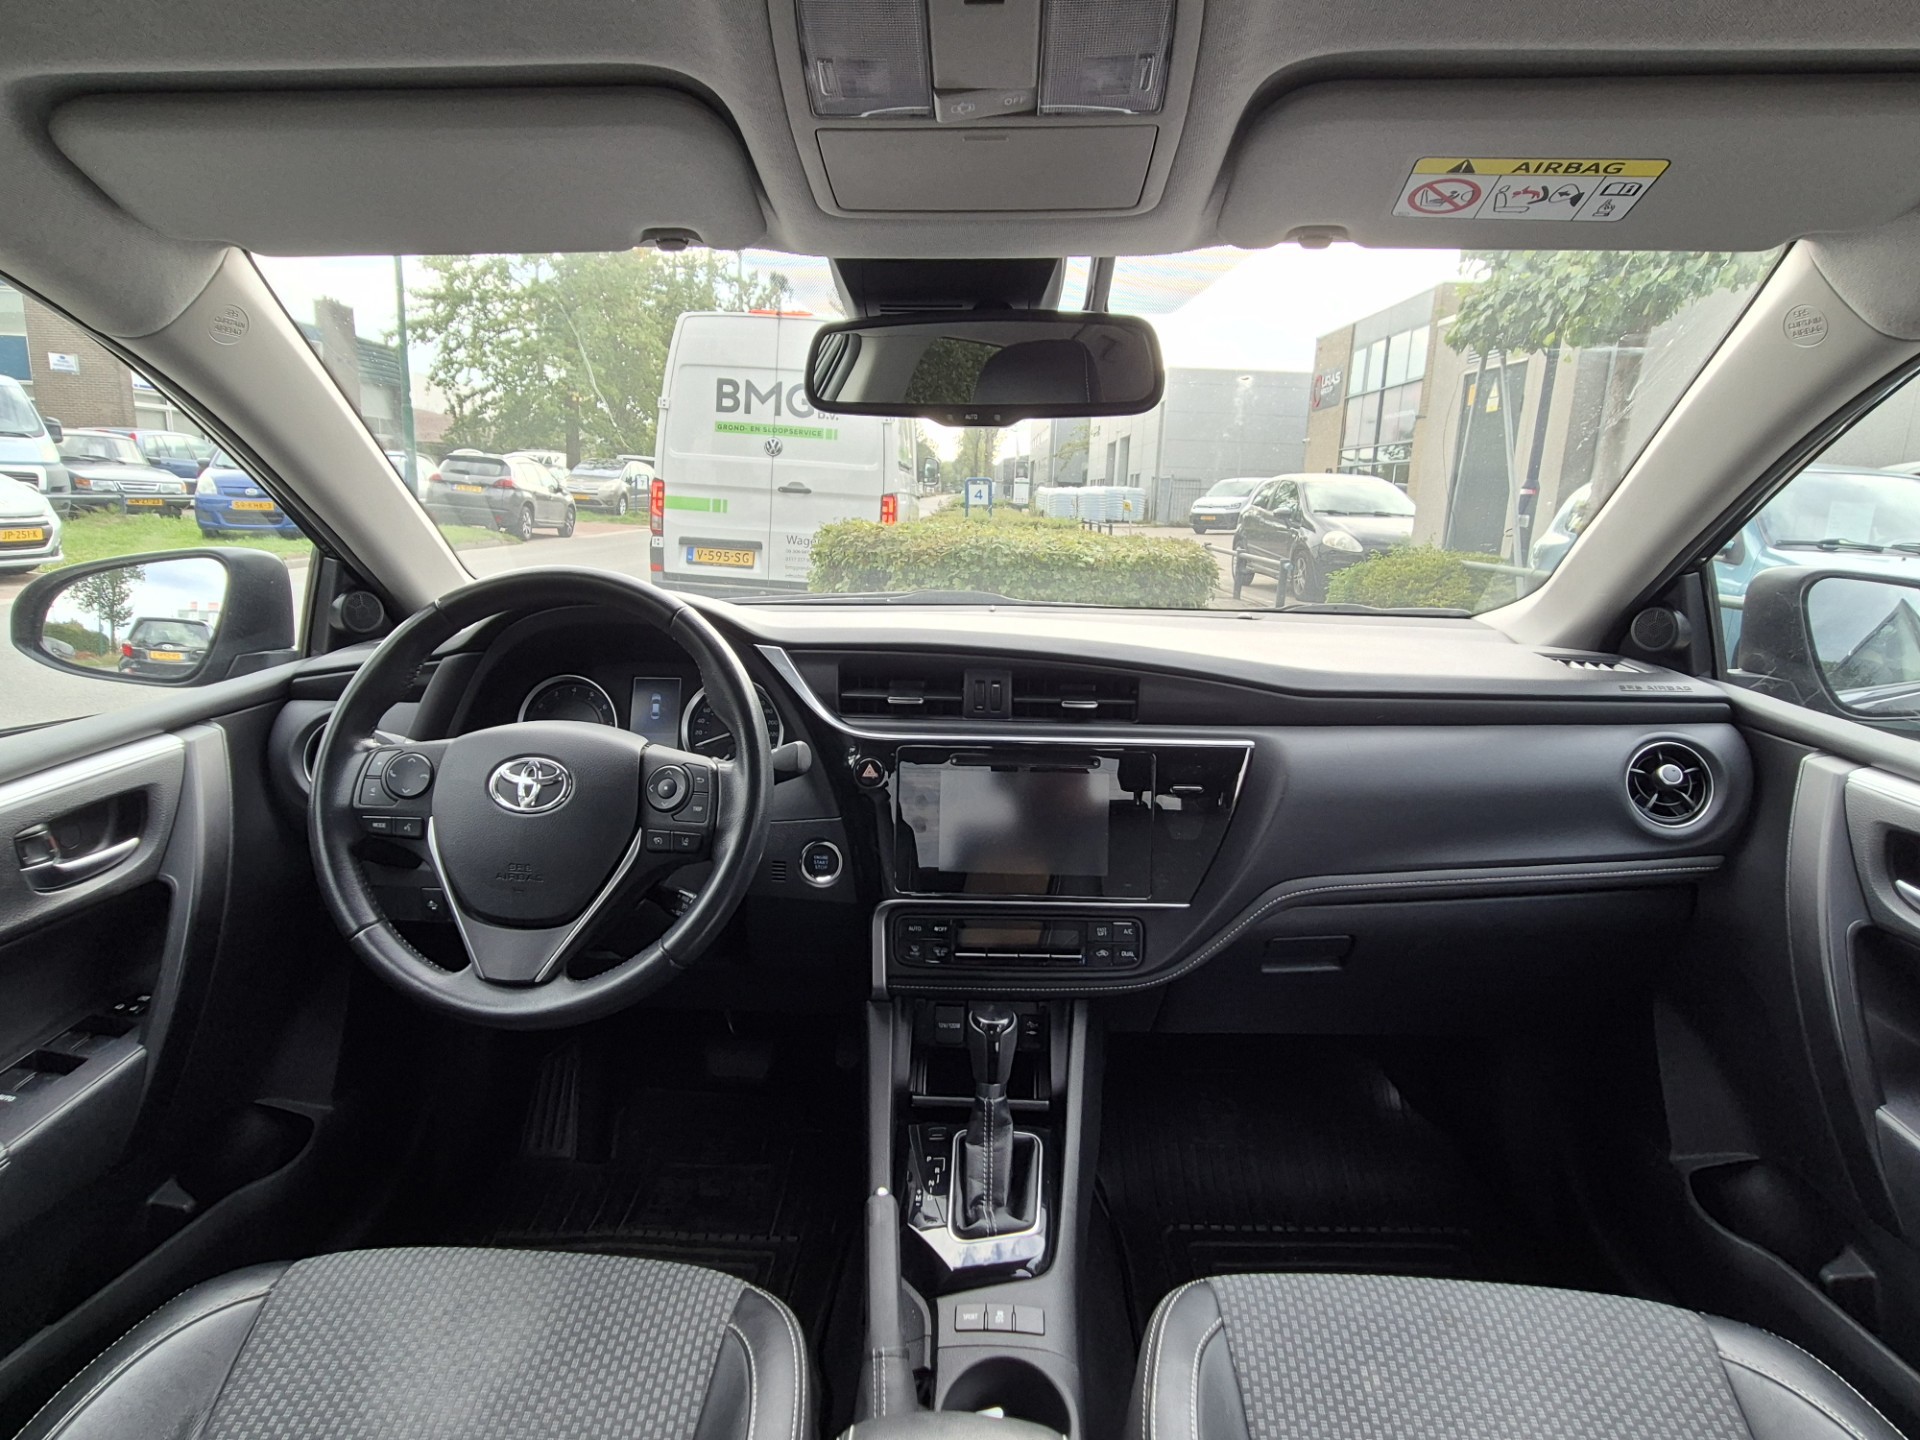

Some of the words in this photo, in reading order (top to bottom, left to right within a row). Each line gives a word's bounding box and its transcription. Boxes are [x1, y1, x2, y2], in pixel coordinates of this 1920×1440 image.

[1511, 161, 1626, 175] AIRBAG
[213, 325, 242, 337] AIRBAG
[1792, 325, 1822, 338] AIRBAG
[716, 377, 815, 419] BMG
[717, 423, 748, 432] GROND-
[763, 427, 822, 437] SLOOPSERVICE
[974, 489, 983, 500] 4
[697, 549, 750, 563] V-595-SG
[928, 1179, 935, 1187] N
